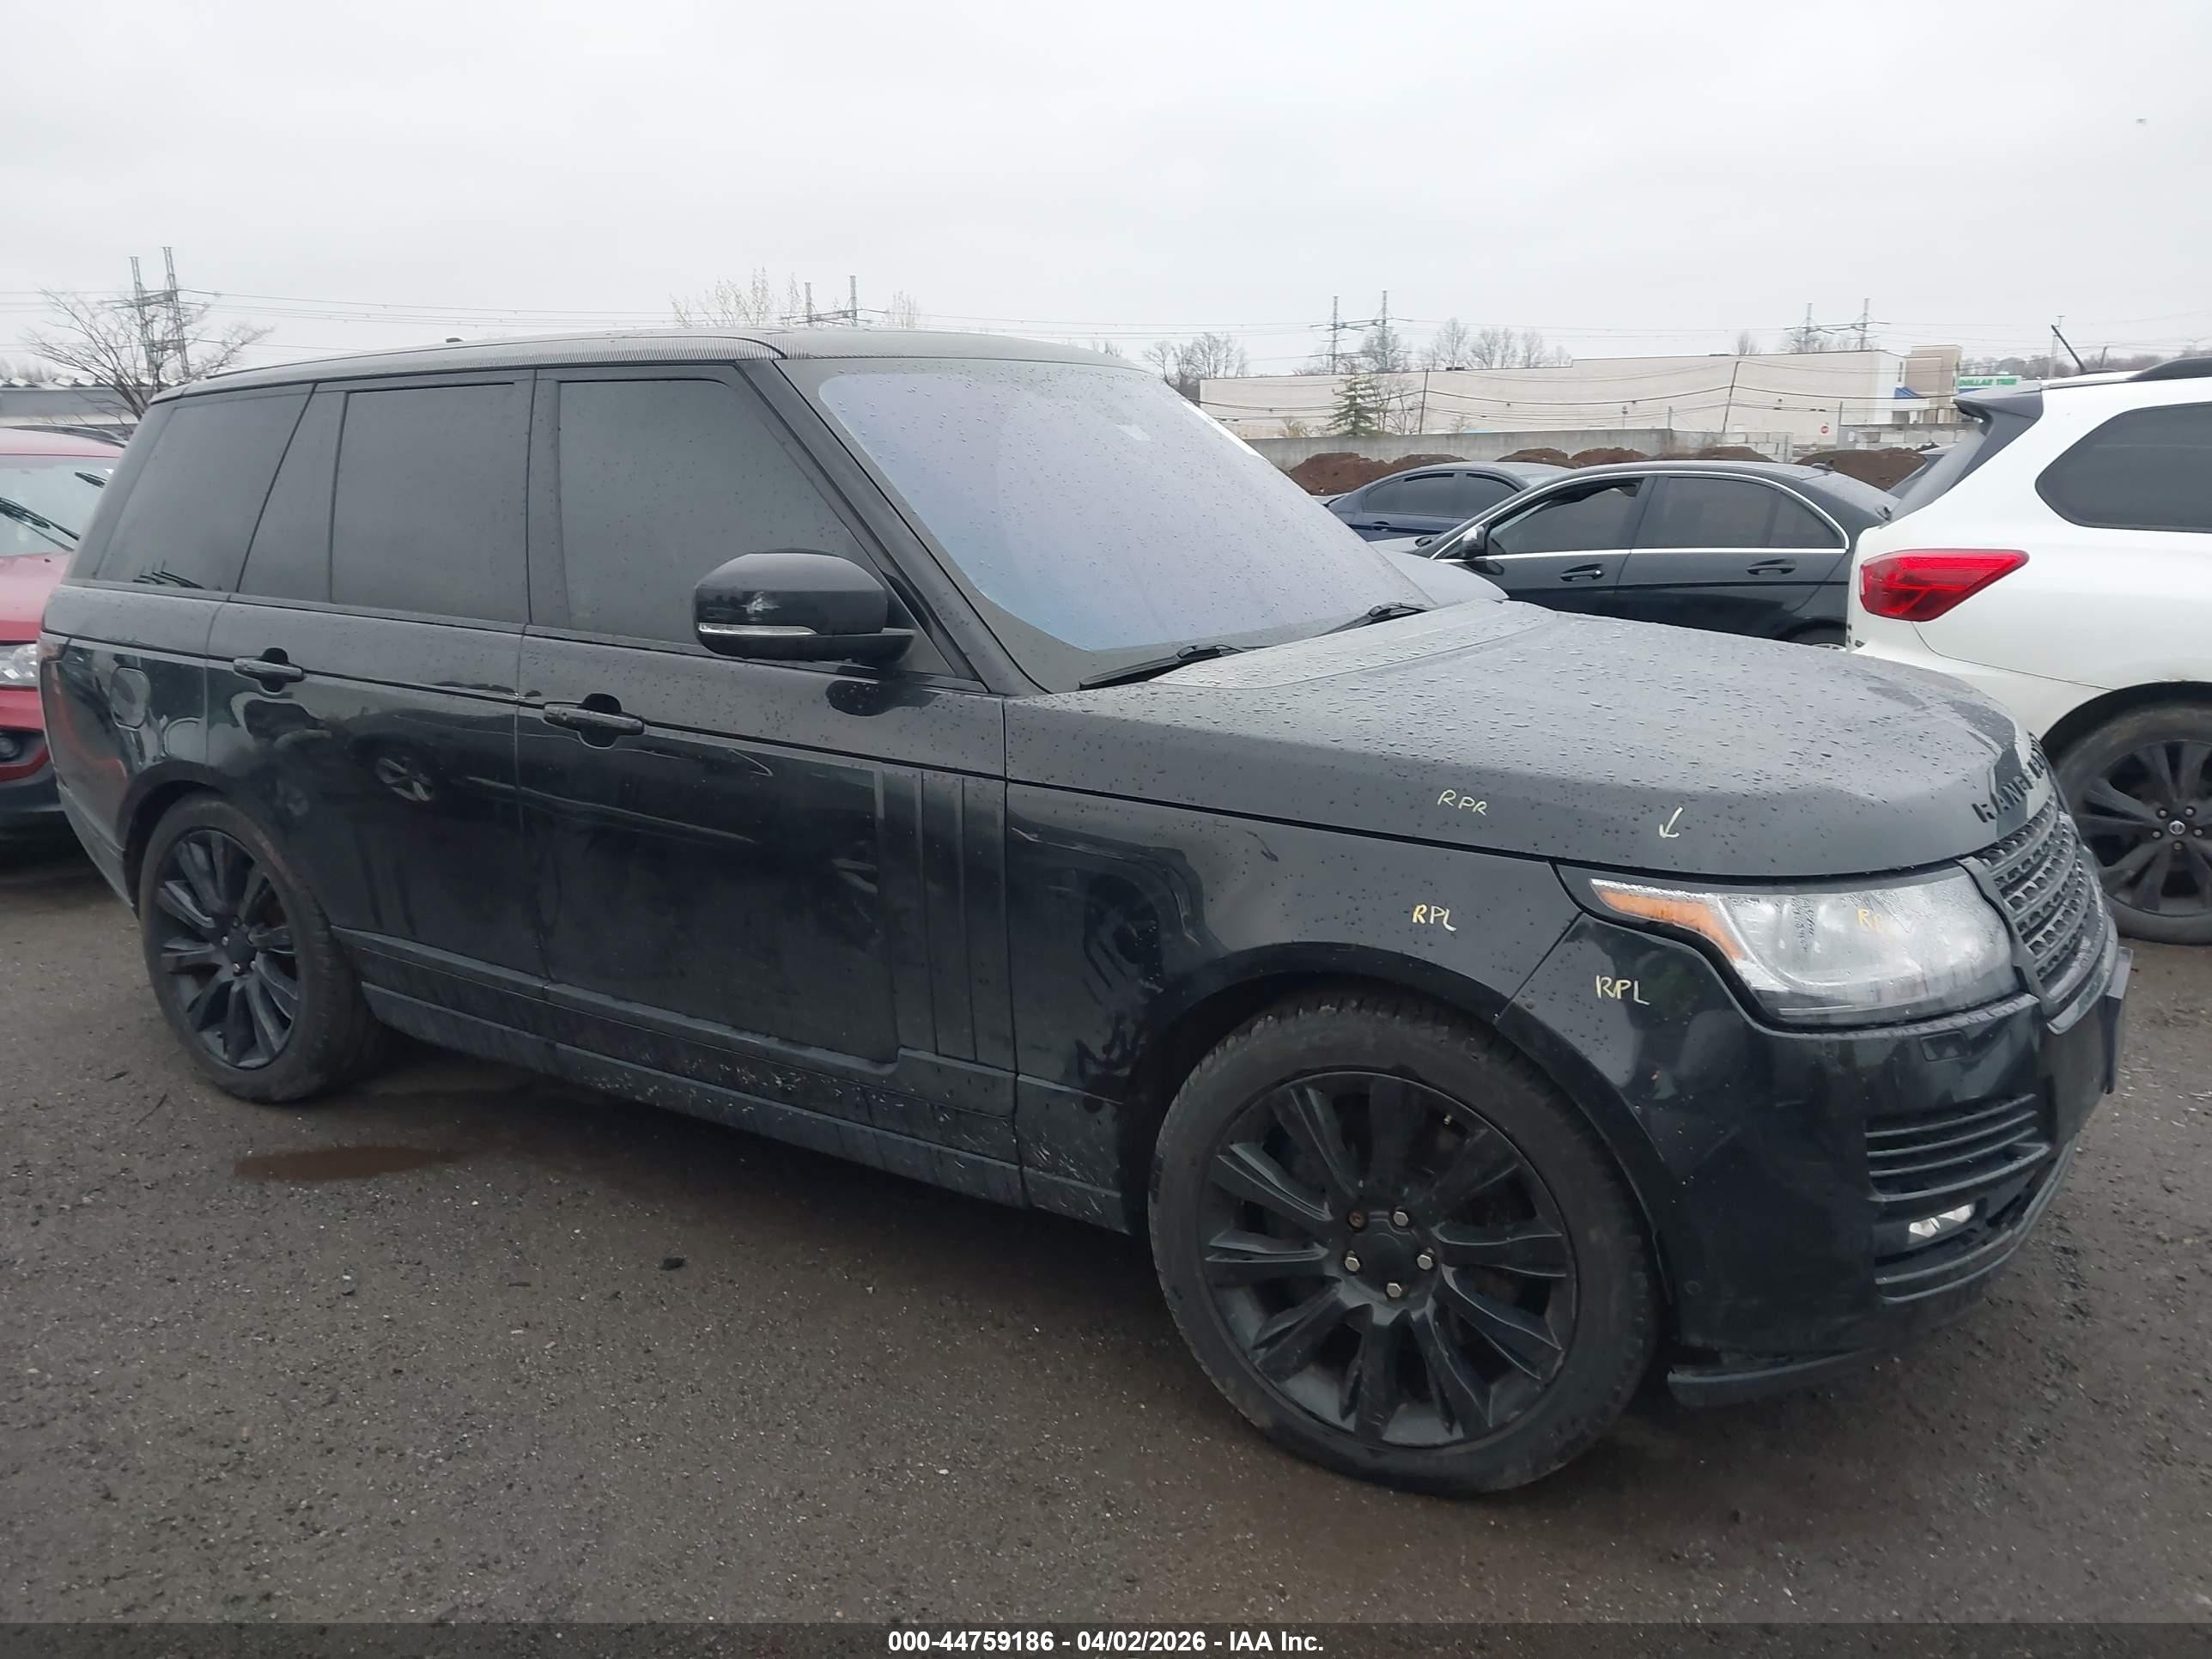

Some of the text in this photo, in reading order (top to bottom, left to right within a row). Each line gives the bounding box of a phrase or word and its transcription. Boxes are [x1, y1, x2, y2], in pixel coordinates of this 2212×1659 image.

[1437, 789, 1487, 816] RPR
[1412, 904, 1456, 932] RPL
[1595, 975, 1650, 1006] RPL
